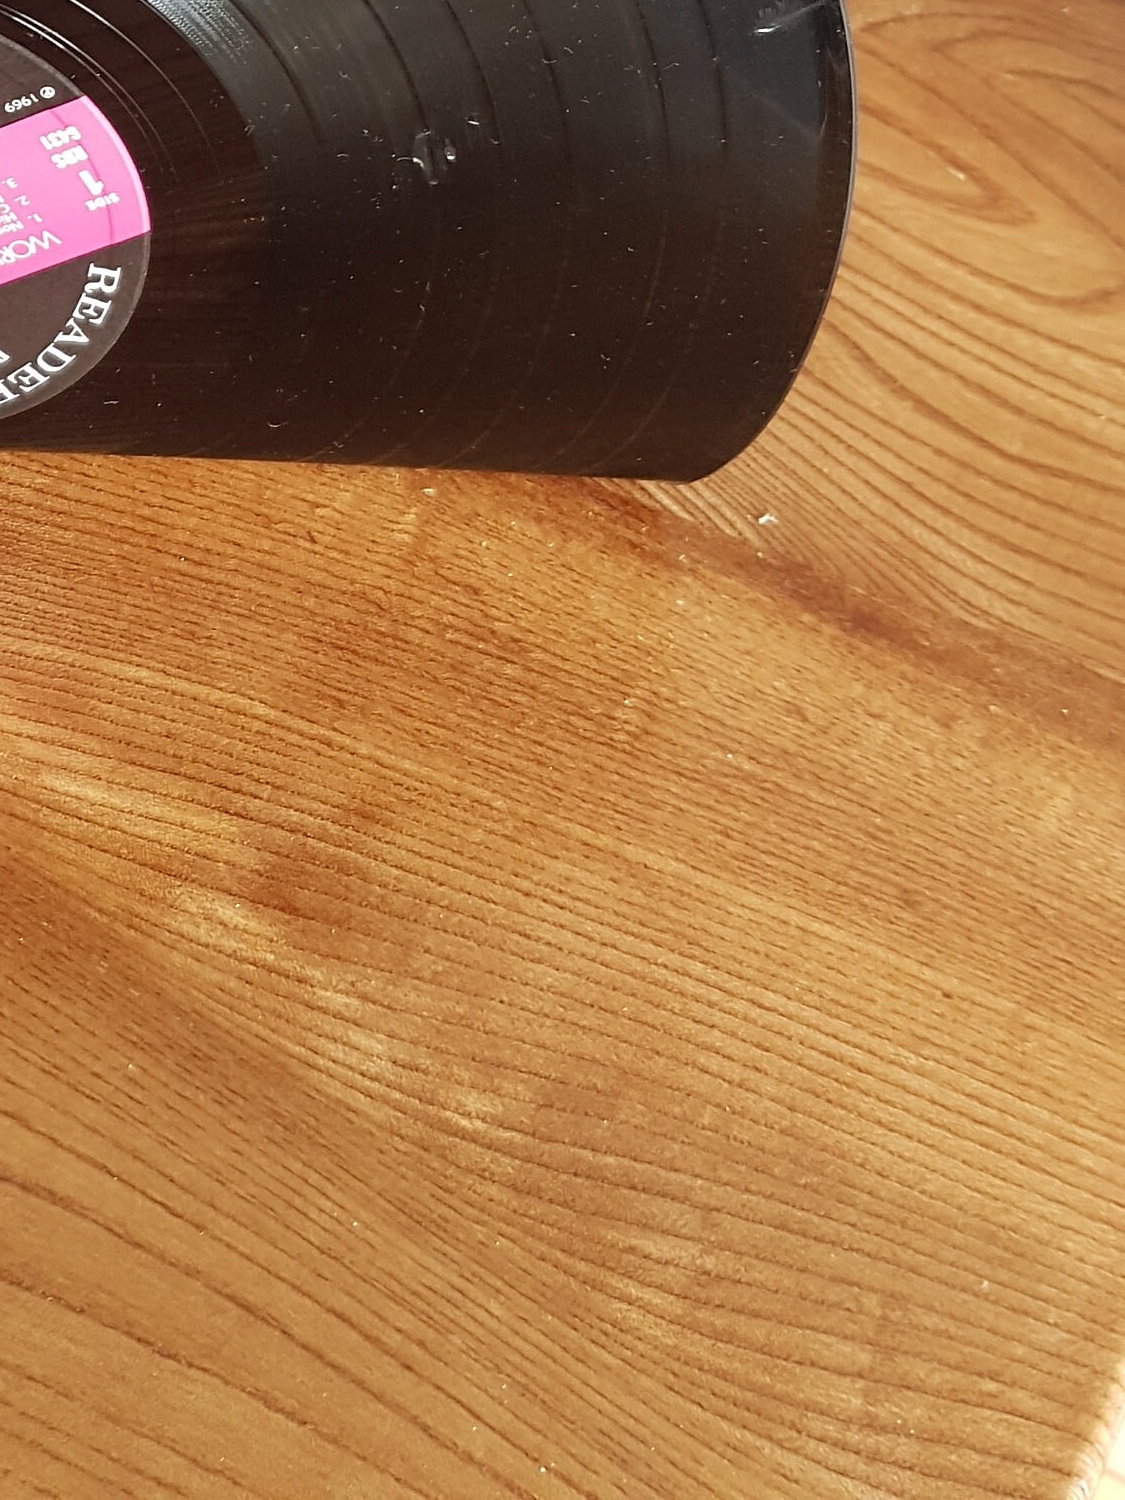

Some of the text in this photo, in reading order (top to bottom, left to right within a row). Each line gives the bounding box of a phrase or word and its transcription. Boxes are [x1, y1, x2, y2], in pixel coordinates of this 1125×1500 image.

[4, 93, 39, 113] 1969
[39, 125, 81, 150] 6431
[1, 177, 18, 189] 3.
[78, 169, 104, 196] 1
[13, 194, 30, 206] 2.
[84, 192, 120, 211] SIDE
[26, 213, 43, 223] 1.
